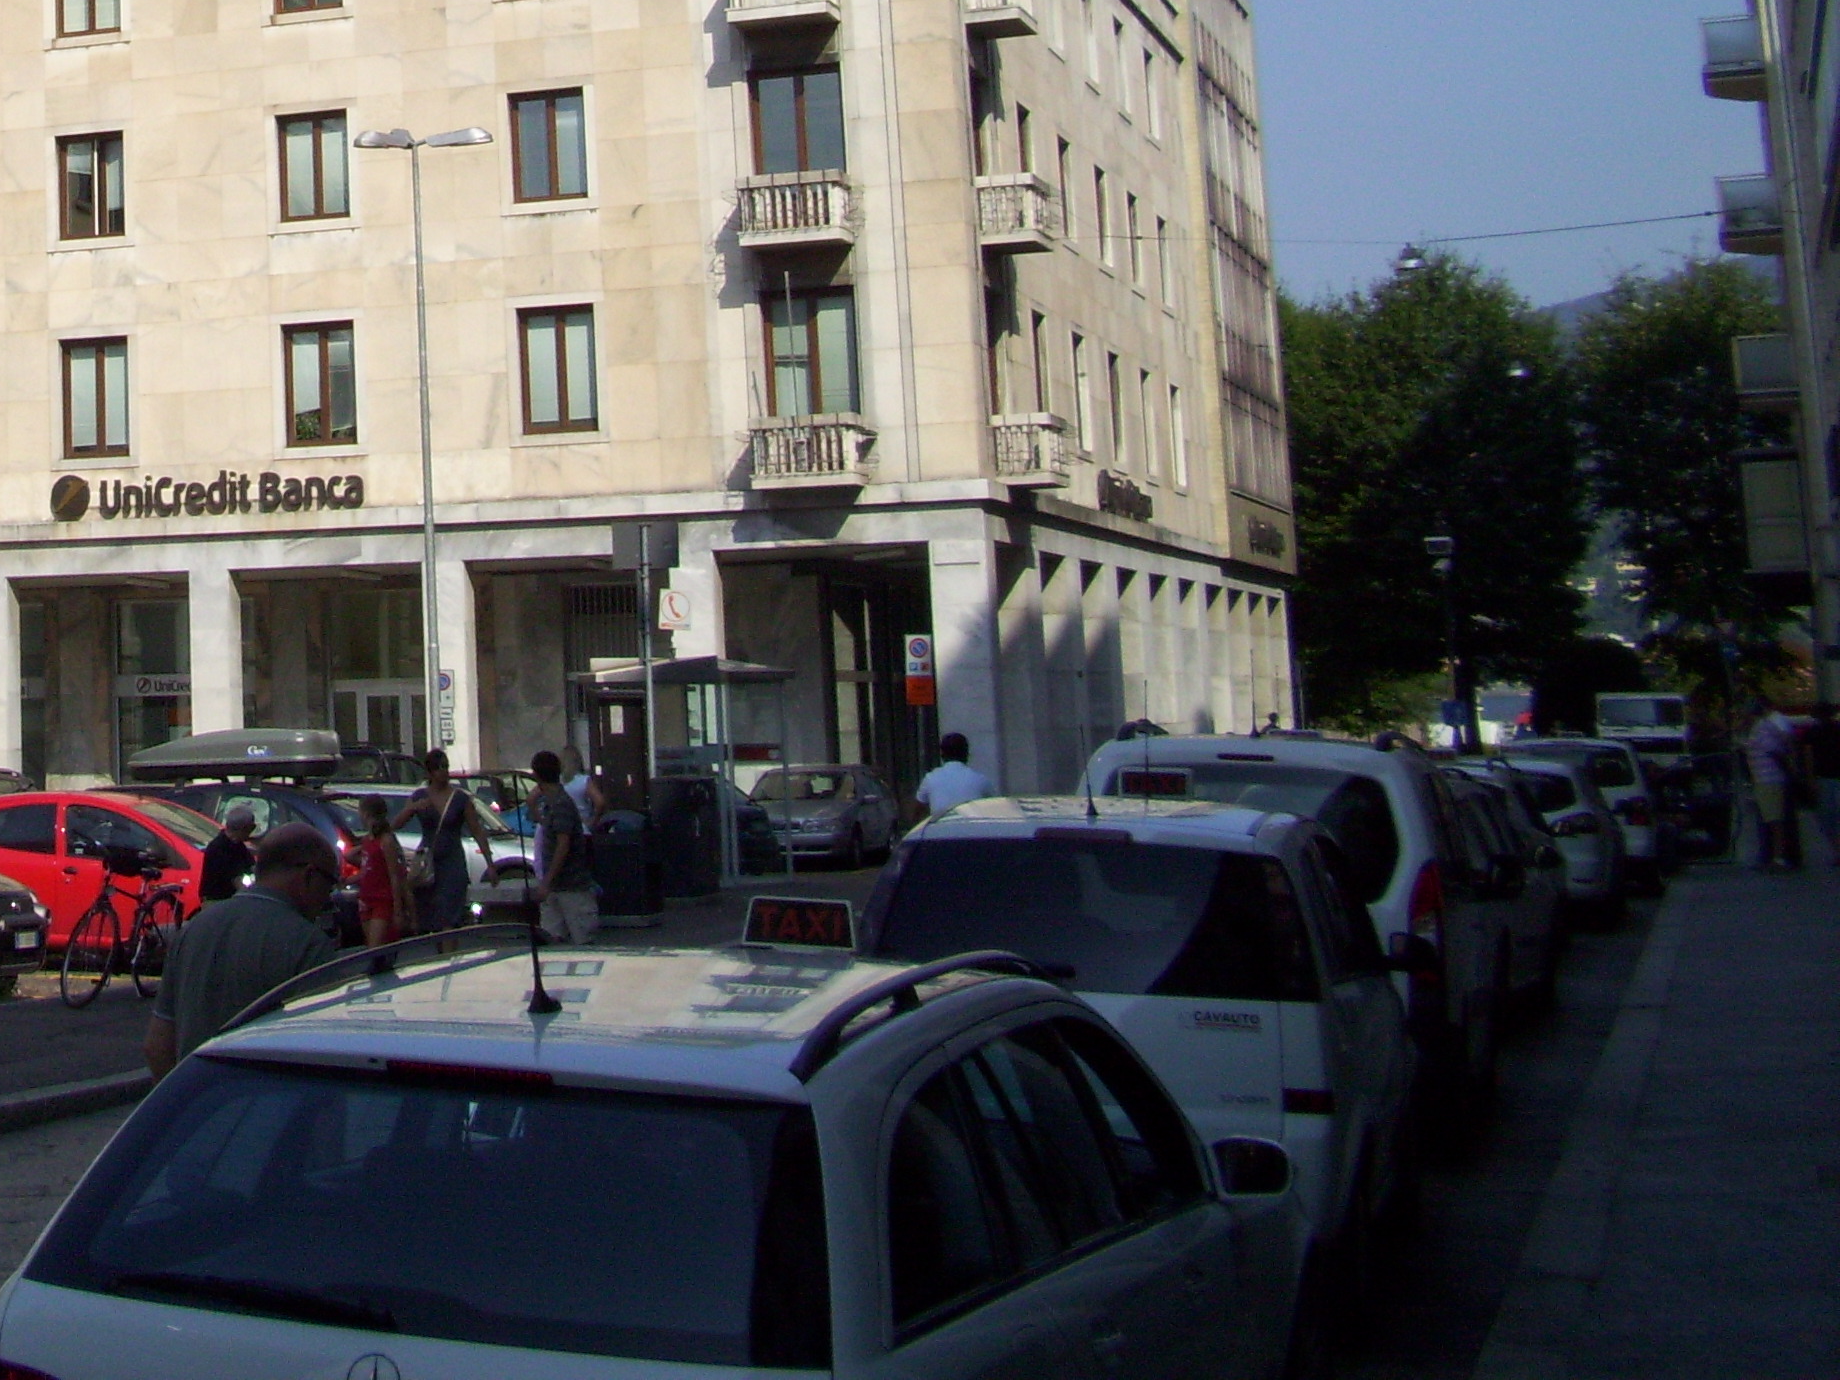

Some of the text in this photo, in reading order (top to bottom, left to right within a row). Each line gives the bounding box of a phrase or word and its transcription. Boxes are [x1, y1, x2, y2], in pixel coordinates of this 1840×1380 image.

[98, 469, 365, 519] UniCredit Banca
[757, 904, 844, 941] TAXI
[1194, 1010, 1261, 1025] CAVAUTO
